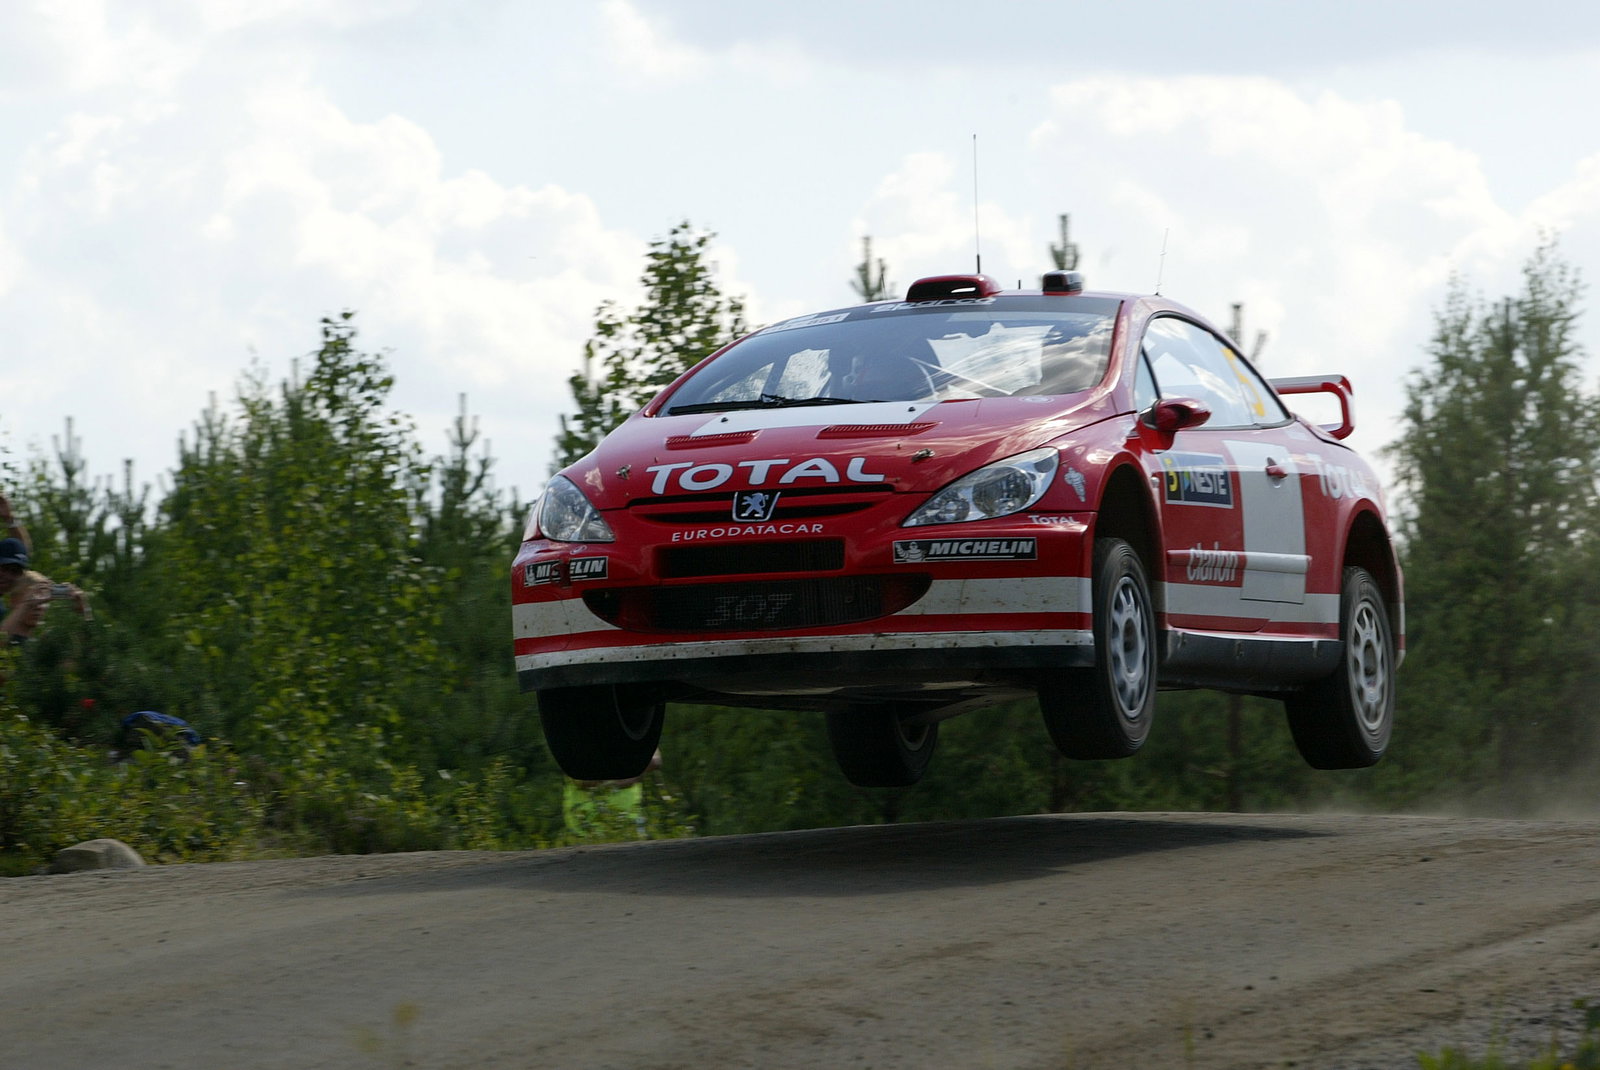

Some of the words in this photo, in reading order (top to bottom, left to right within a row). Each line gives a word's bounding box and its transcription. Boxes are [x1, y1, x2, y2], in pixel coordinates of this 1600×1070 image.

[646, 457, 885, 495] TOTAL
[1190, 466, 1227, 495] NESTE
[1028, 515, 1080, 525] TOTAL
[671, 523, 824, 542] EURODATACAR
[929, 541, 1033, 555] MICHELIN
[705, 593, 792, 626] 307
